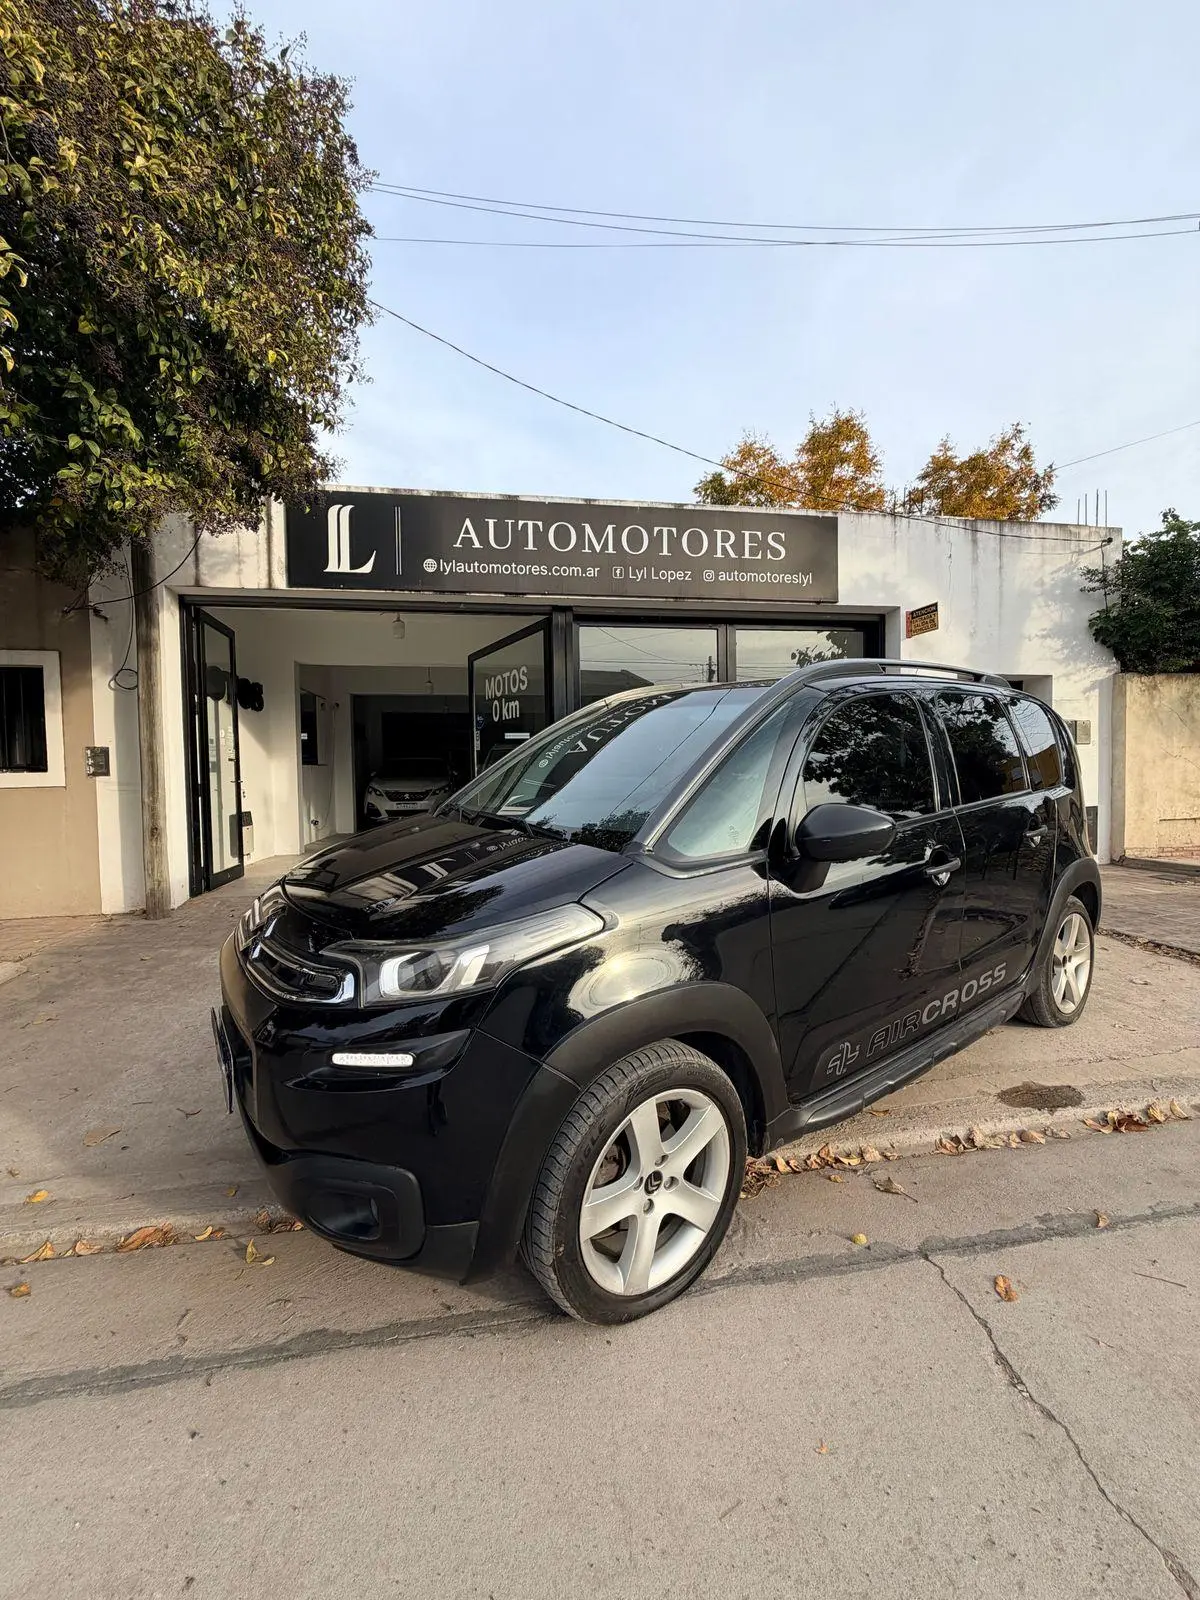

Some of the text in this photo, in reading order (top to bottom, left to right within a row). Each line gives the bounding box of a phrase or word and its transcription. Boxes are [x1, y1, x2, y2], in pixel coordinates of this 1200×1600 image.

[453, 517, 786, 561] AUTOMOTORES
[440, 559, 600, 578] lylautomotores.com.ar
[629, 566, 692, 583] Lyl Lopez
[718, 569, 813, 586] automotoreslyl
[485, 665, 528, 700] MOTOS
[492, 698, 520, 722] 0 km
[866, 962, 1007, 1058] AIRCROSS
